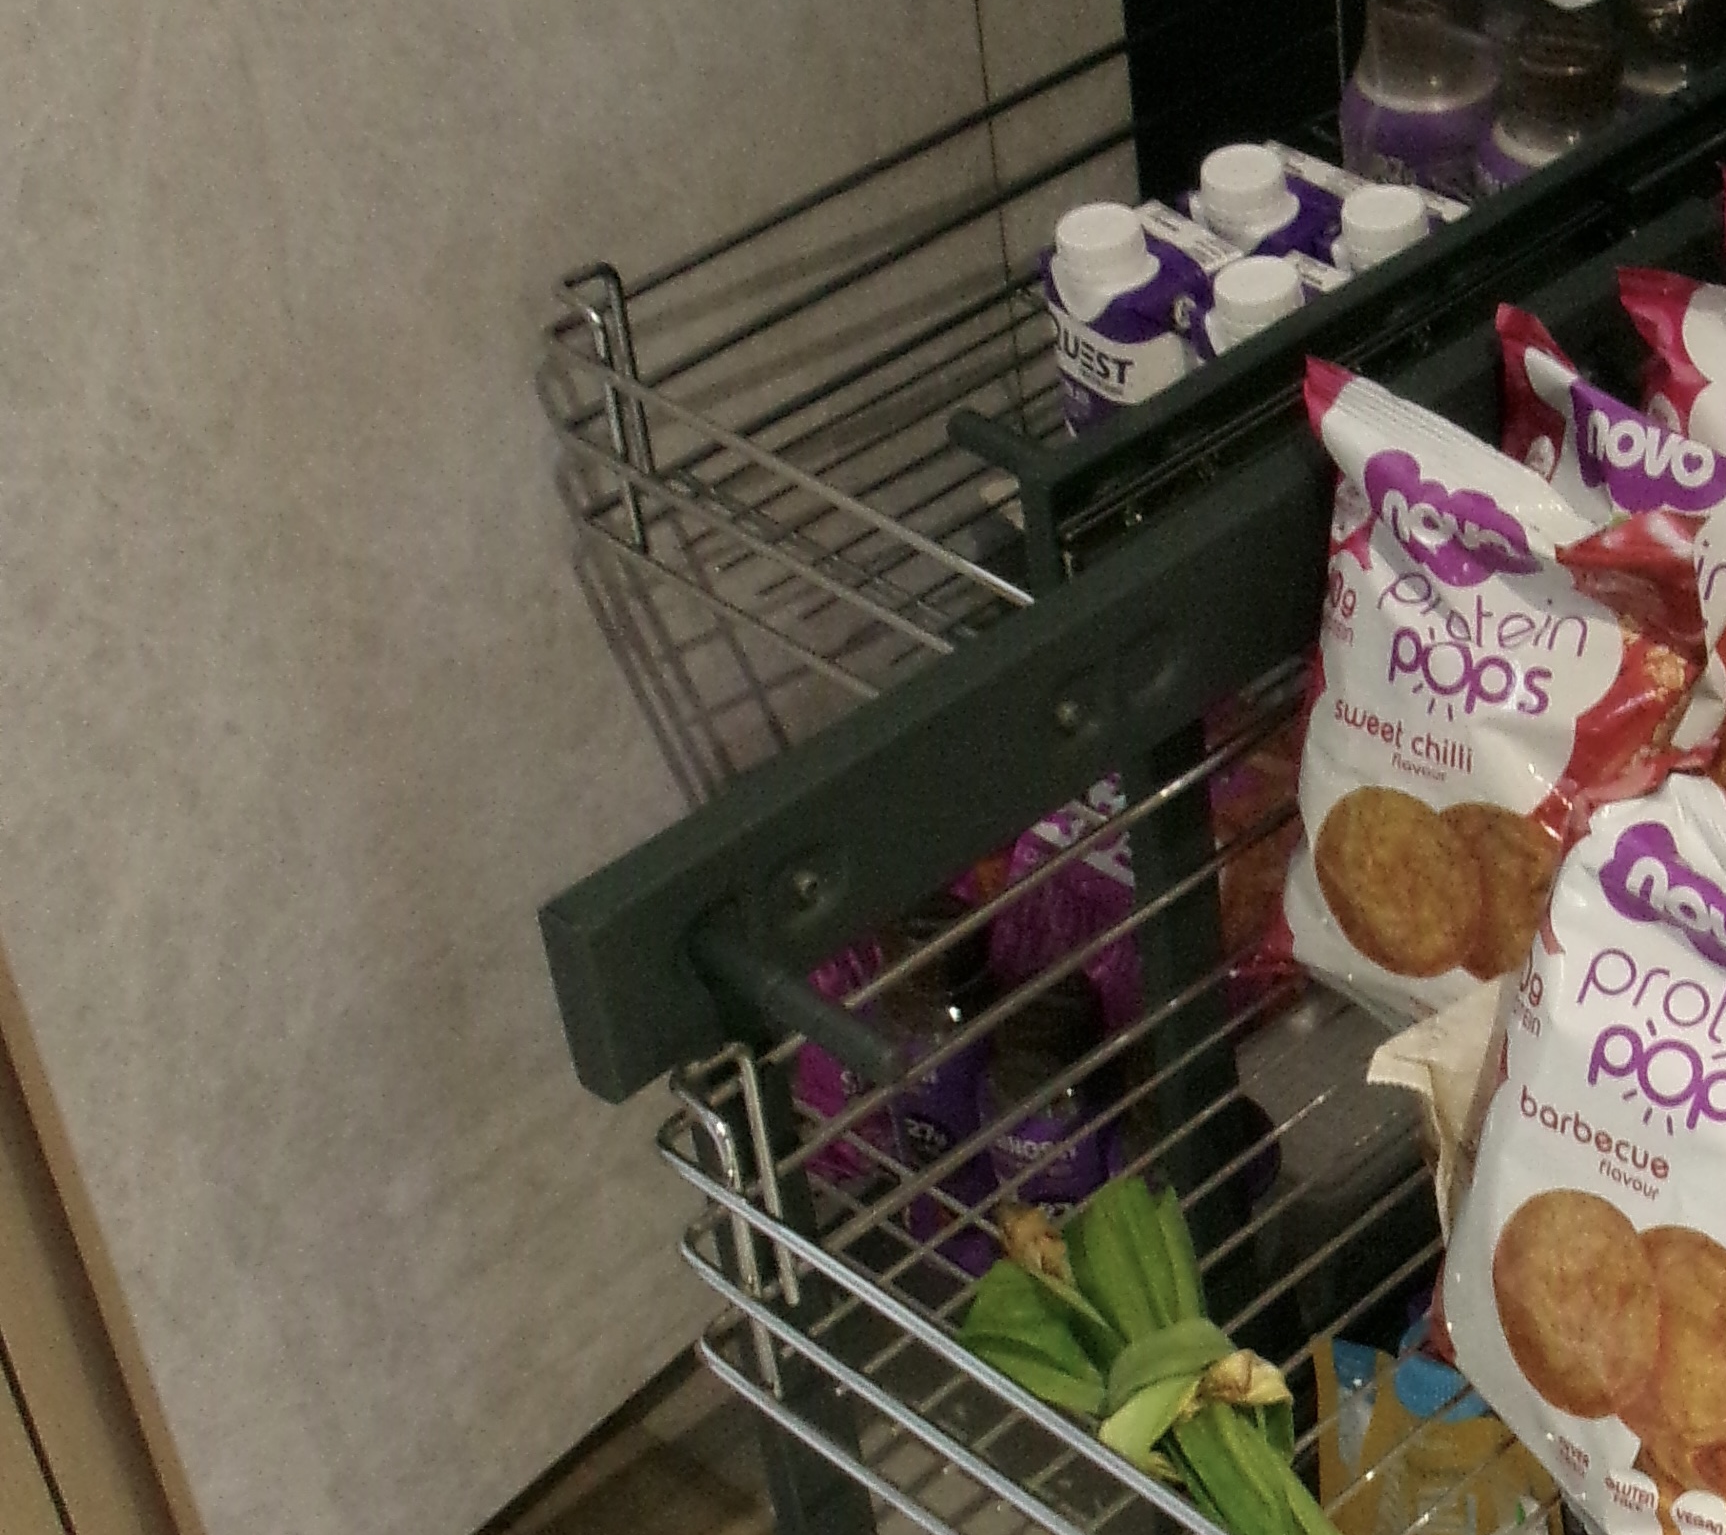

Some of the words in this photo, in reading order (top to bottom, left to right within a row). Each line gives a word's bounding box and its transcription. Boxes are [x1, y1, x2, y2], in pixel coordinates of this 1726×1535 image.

[1588, 409, 1717, 488] novo
[1389, 624, 1554, 718] pops
[1334, 698, 1404, 749] sweet
[1411, 731, 1473, 775] chilli
[1520, 1084, 1670, 1180] barbecue
[1599, 1158, 1662, 1201] flavour
